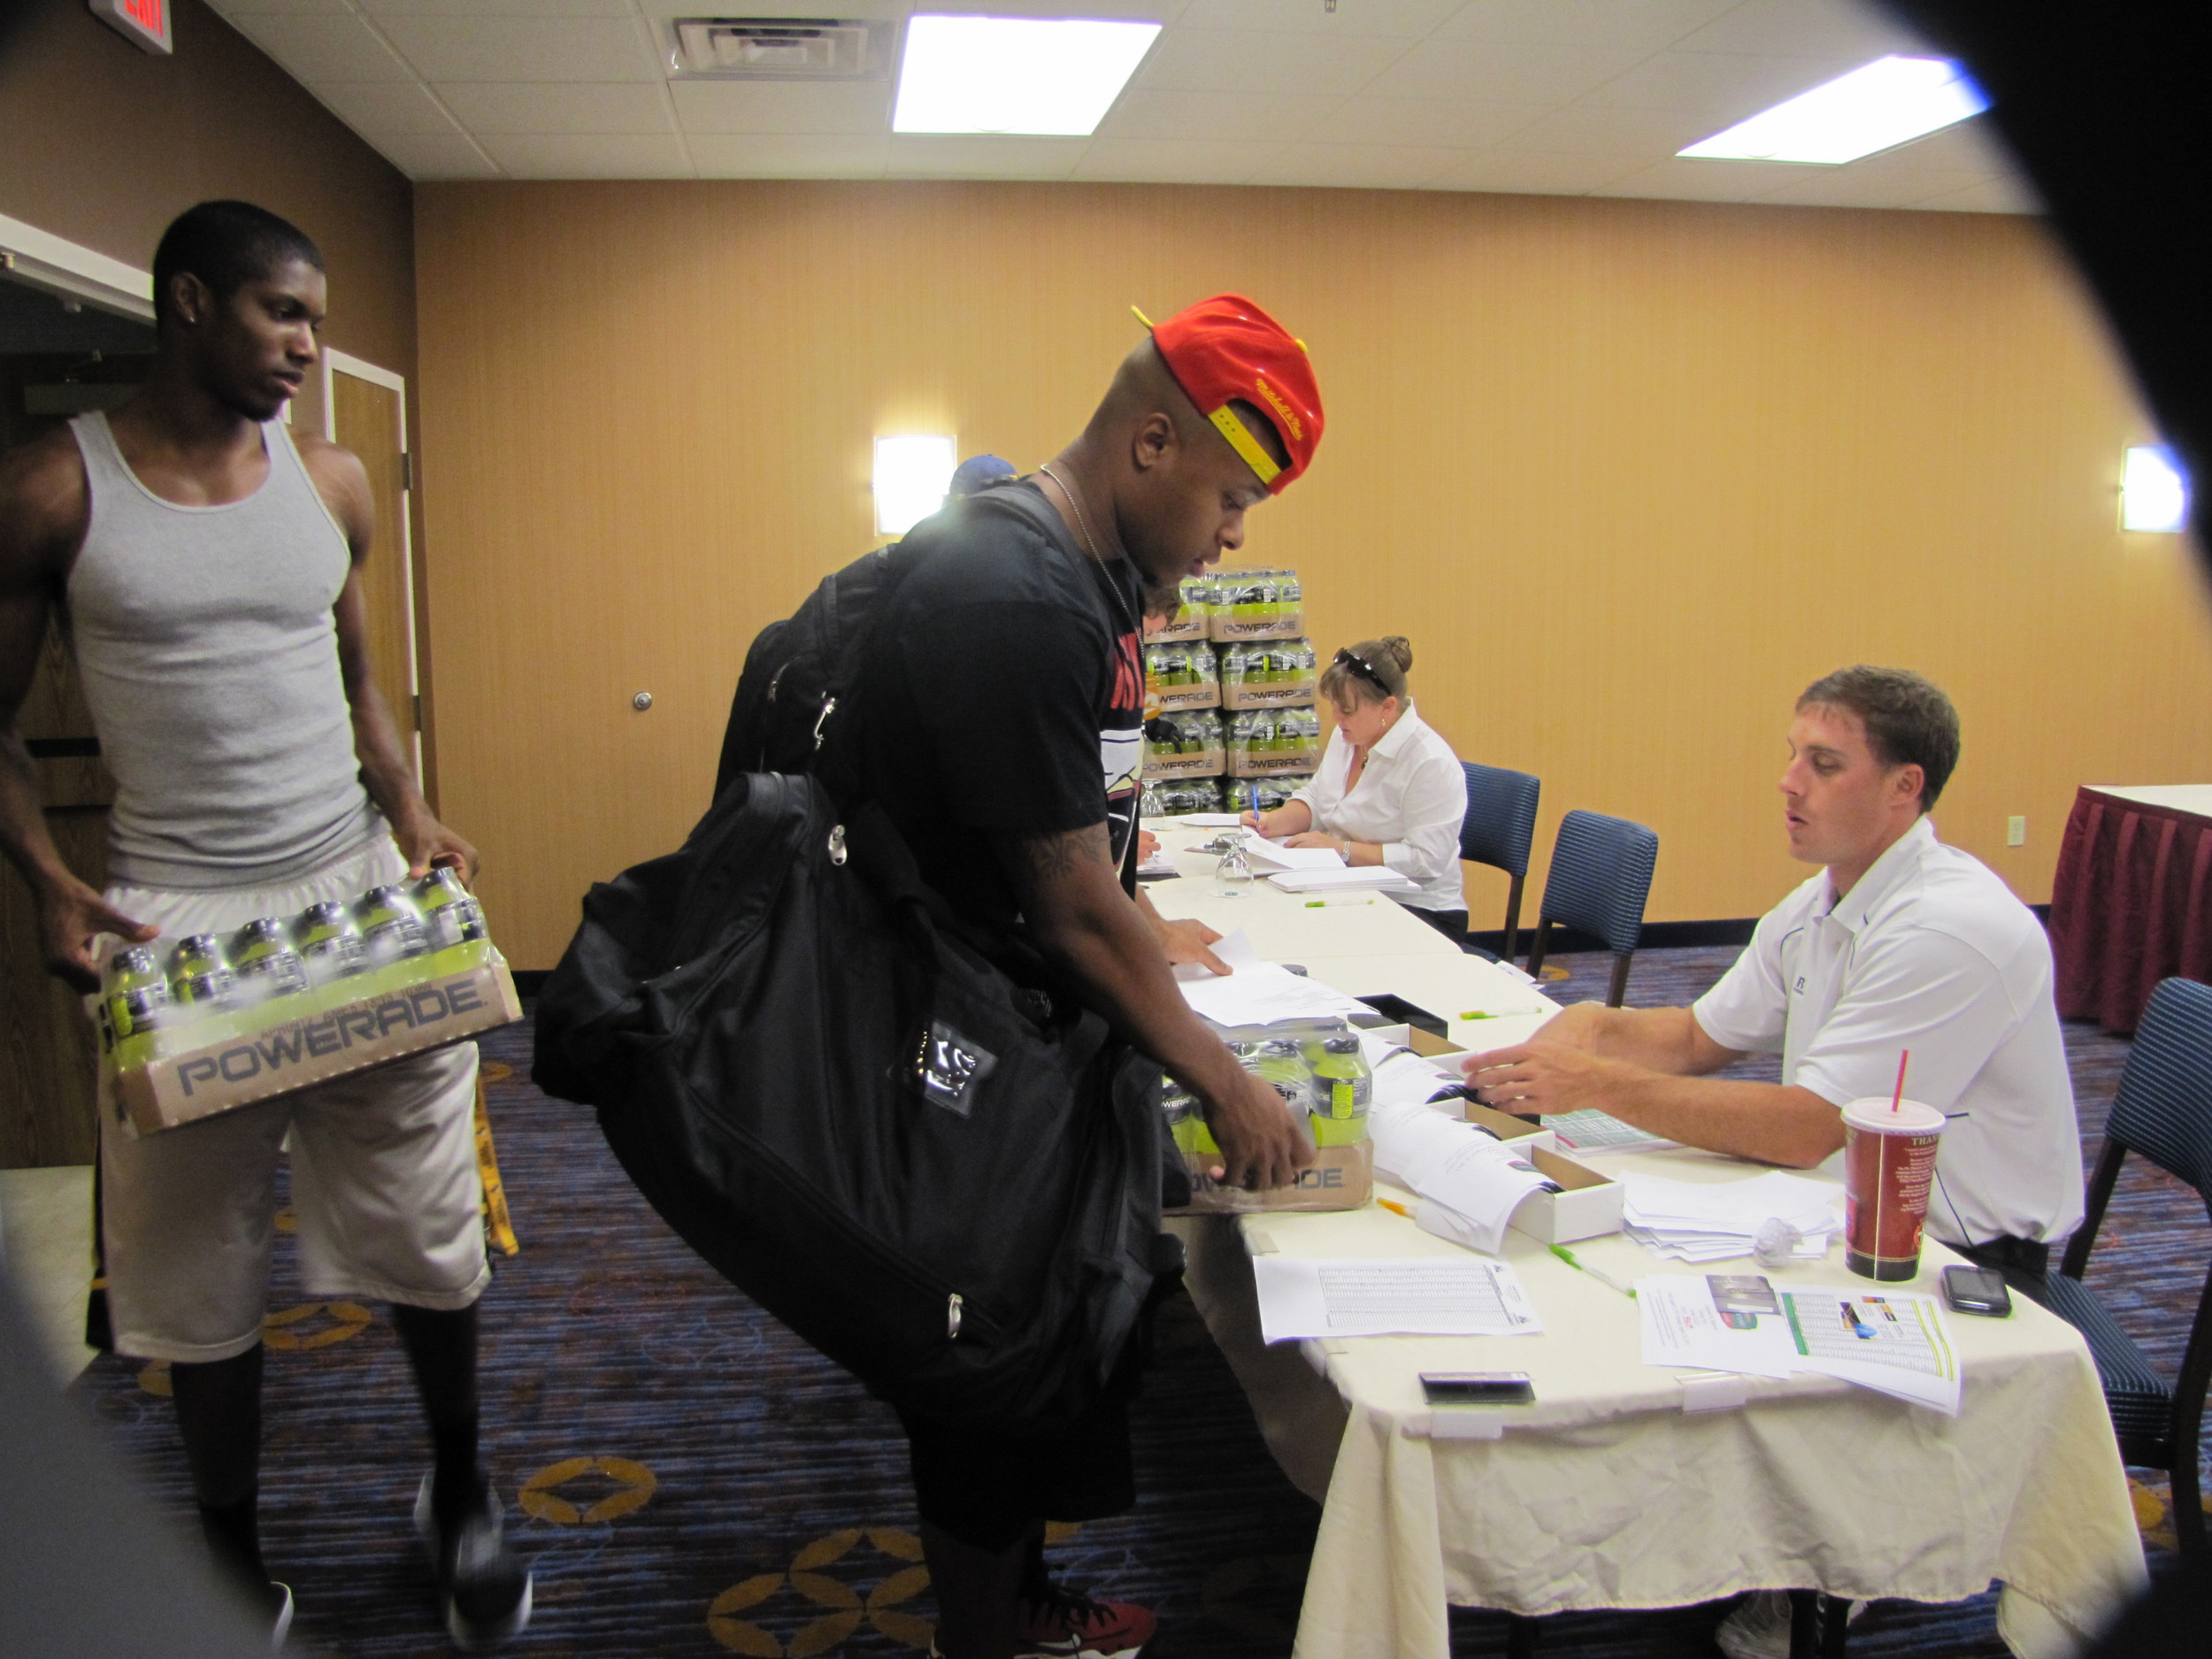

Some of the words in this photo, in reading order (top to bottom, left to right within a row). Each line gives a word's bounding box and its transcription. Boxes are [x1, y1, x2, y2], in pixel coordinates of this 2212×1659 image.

[1224, 620, 1295, 634] POWERADE
[1160, 692, 1213, 703] WERADE
[1239, 688, 1311, 702] POWERADE
[1239, 757, 1310, 772] POWERADE
[178, 978, 484, 1097] POWERADE
